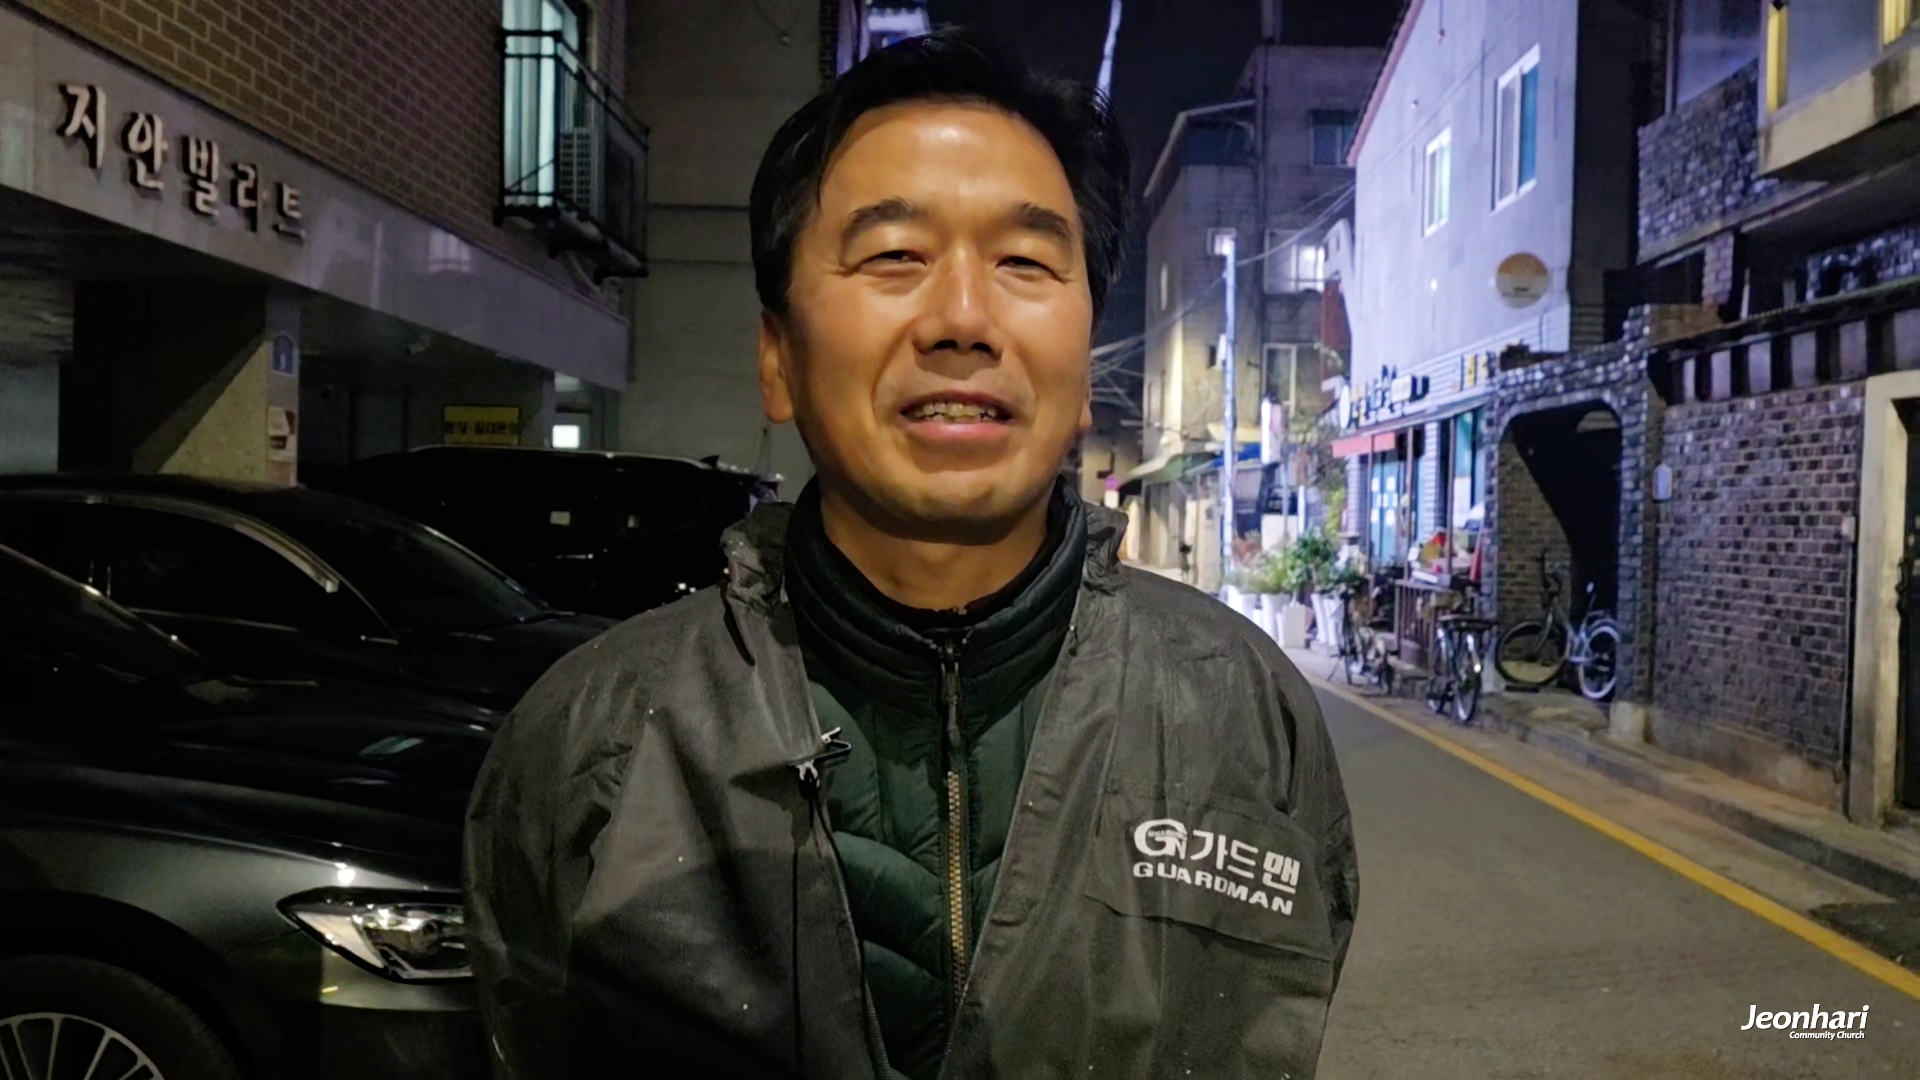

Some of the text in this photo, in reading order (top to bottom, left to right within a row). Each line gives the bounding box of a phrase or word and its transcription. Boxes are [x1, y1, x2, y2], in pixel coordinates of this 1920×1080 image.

[57, 83, 307, 239] 지안빌라트
[1133, 862, 1293, 915] GUARDMAN
[1190, 830, 1300, 894] 가드맨
